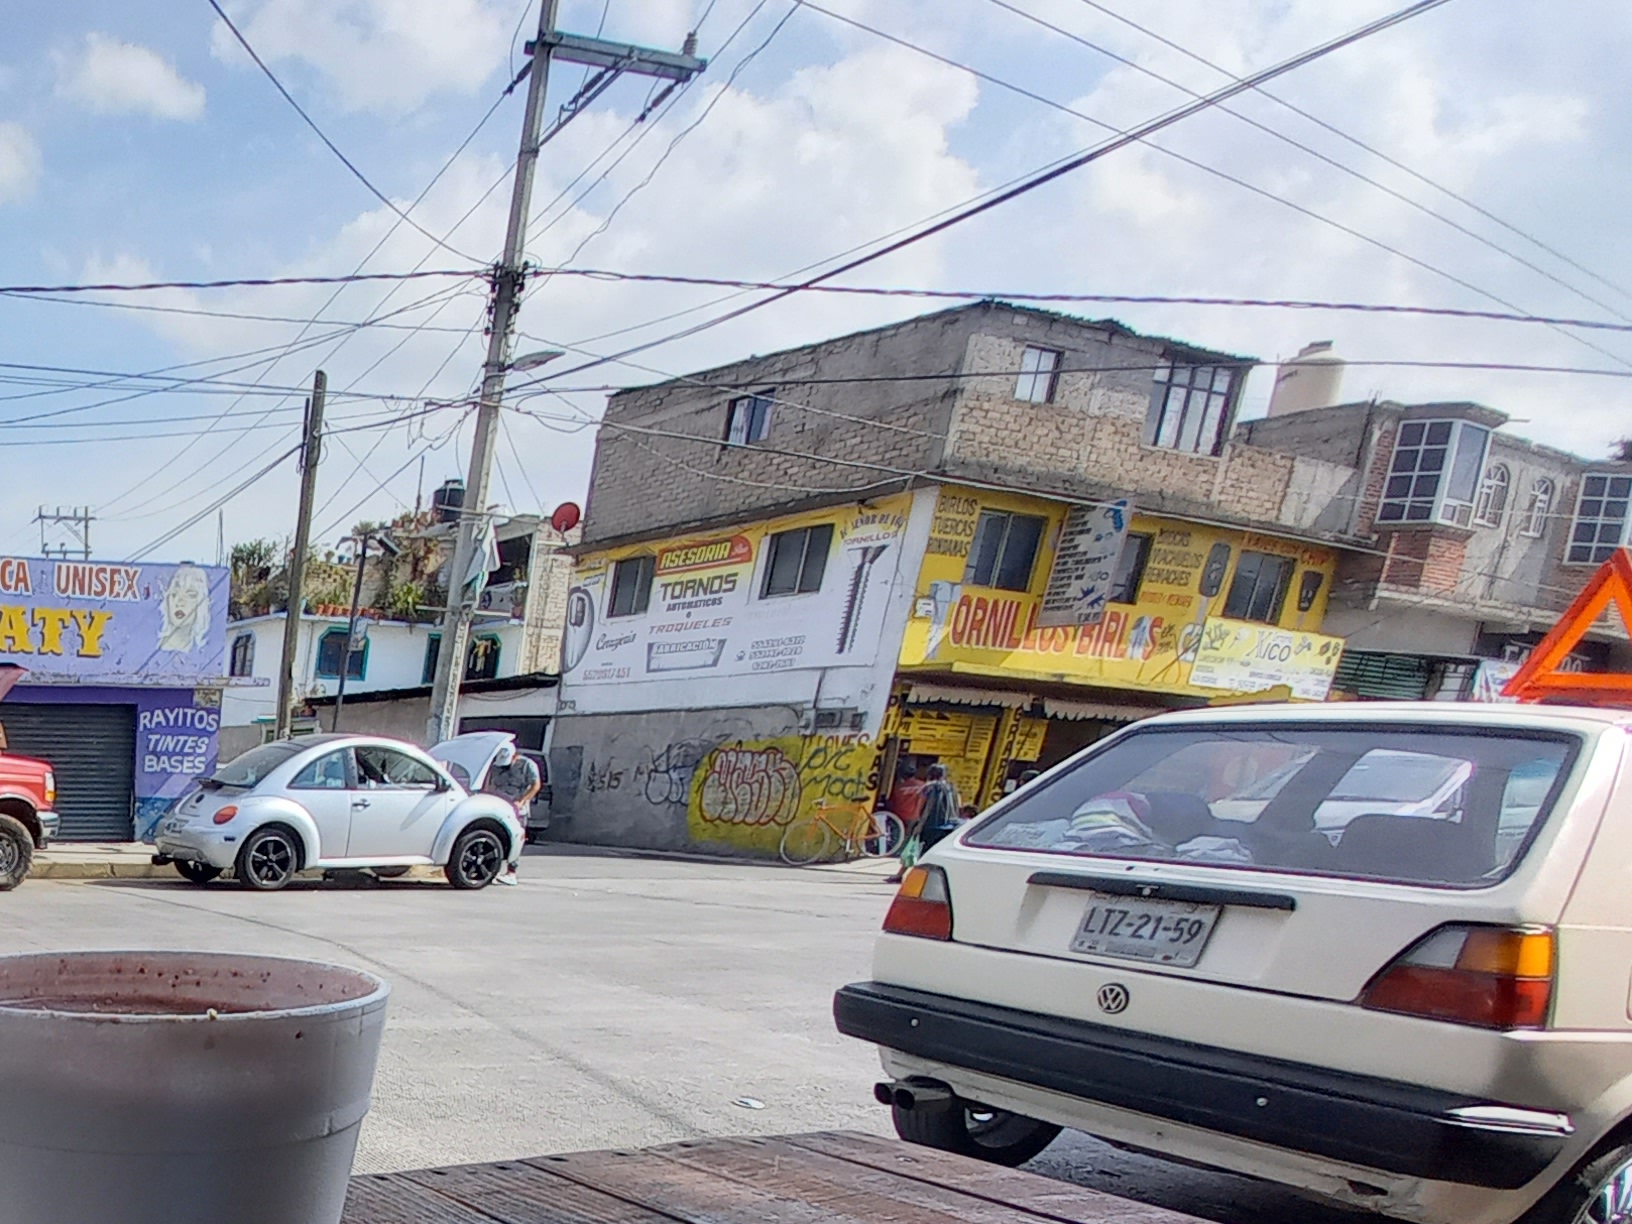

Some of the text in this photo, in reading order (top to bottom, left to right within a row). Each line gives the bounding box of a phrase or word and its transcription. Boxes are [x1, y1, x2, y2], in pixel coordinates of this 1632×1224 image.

[937, 495, 979, 517] BIRLOS
[931, 515, 976, 538] TUERCAS
[660, 542, 732, 570] ASESORIA
[55, 563, 141, 600] UNISEX
[660, 572, 739, 601] TORNOS
[648, 617, 733, 635] TROQUELES
[139, 708, 218, 732] RAYITOS
[147, 734, 209, 753] TINTES
[143, 755, 206, 774] BASES
[1083, 906, 1205, 945] LTZ-21-59
